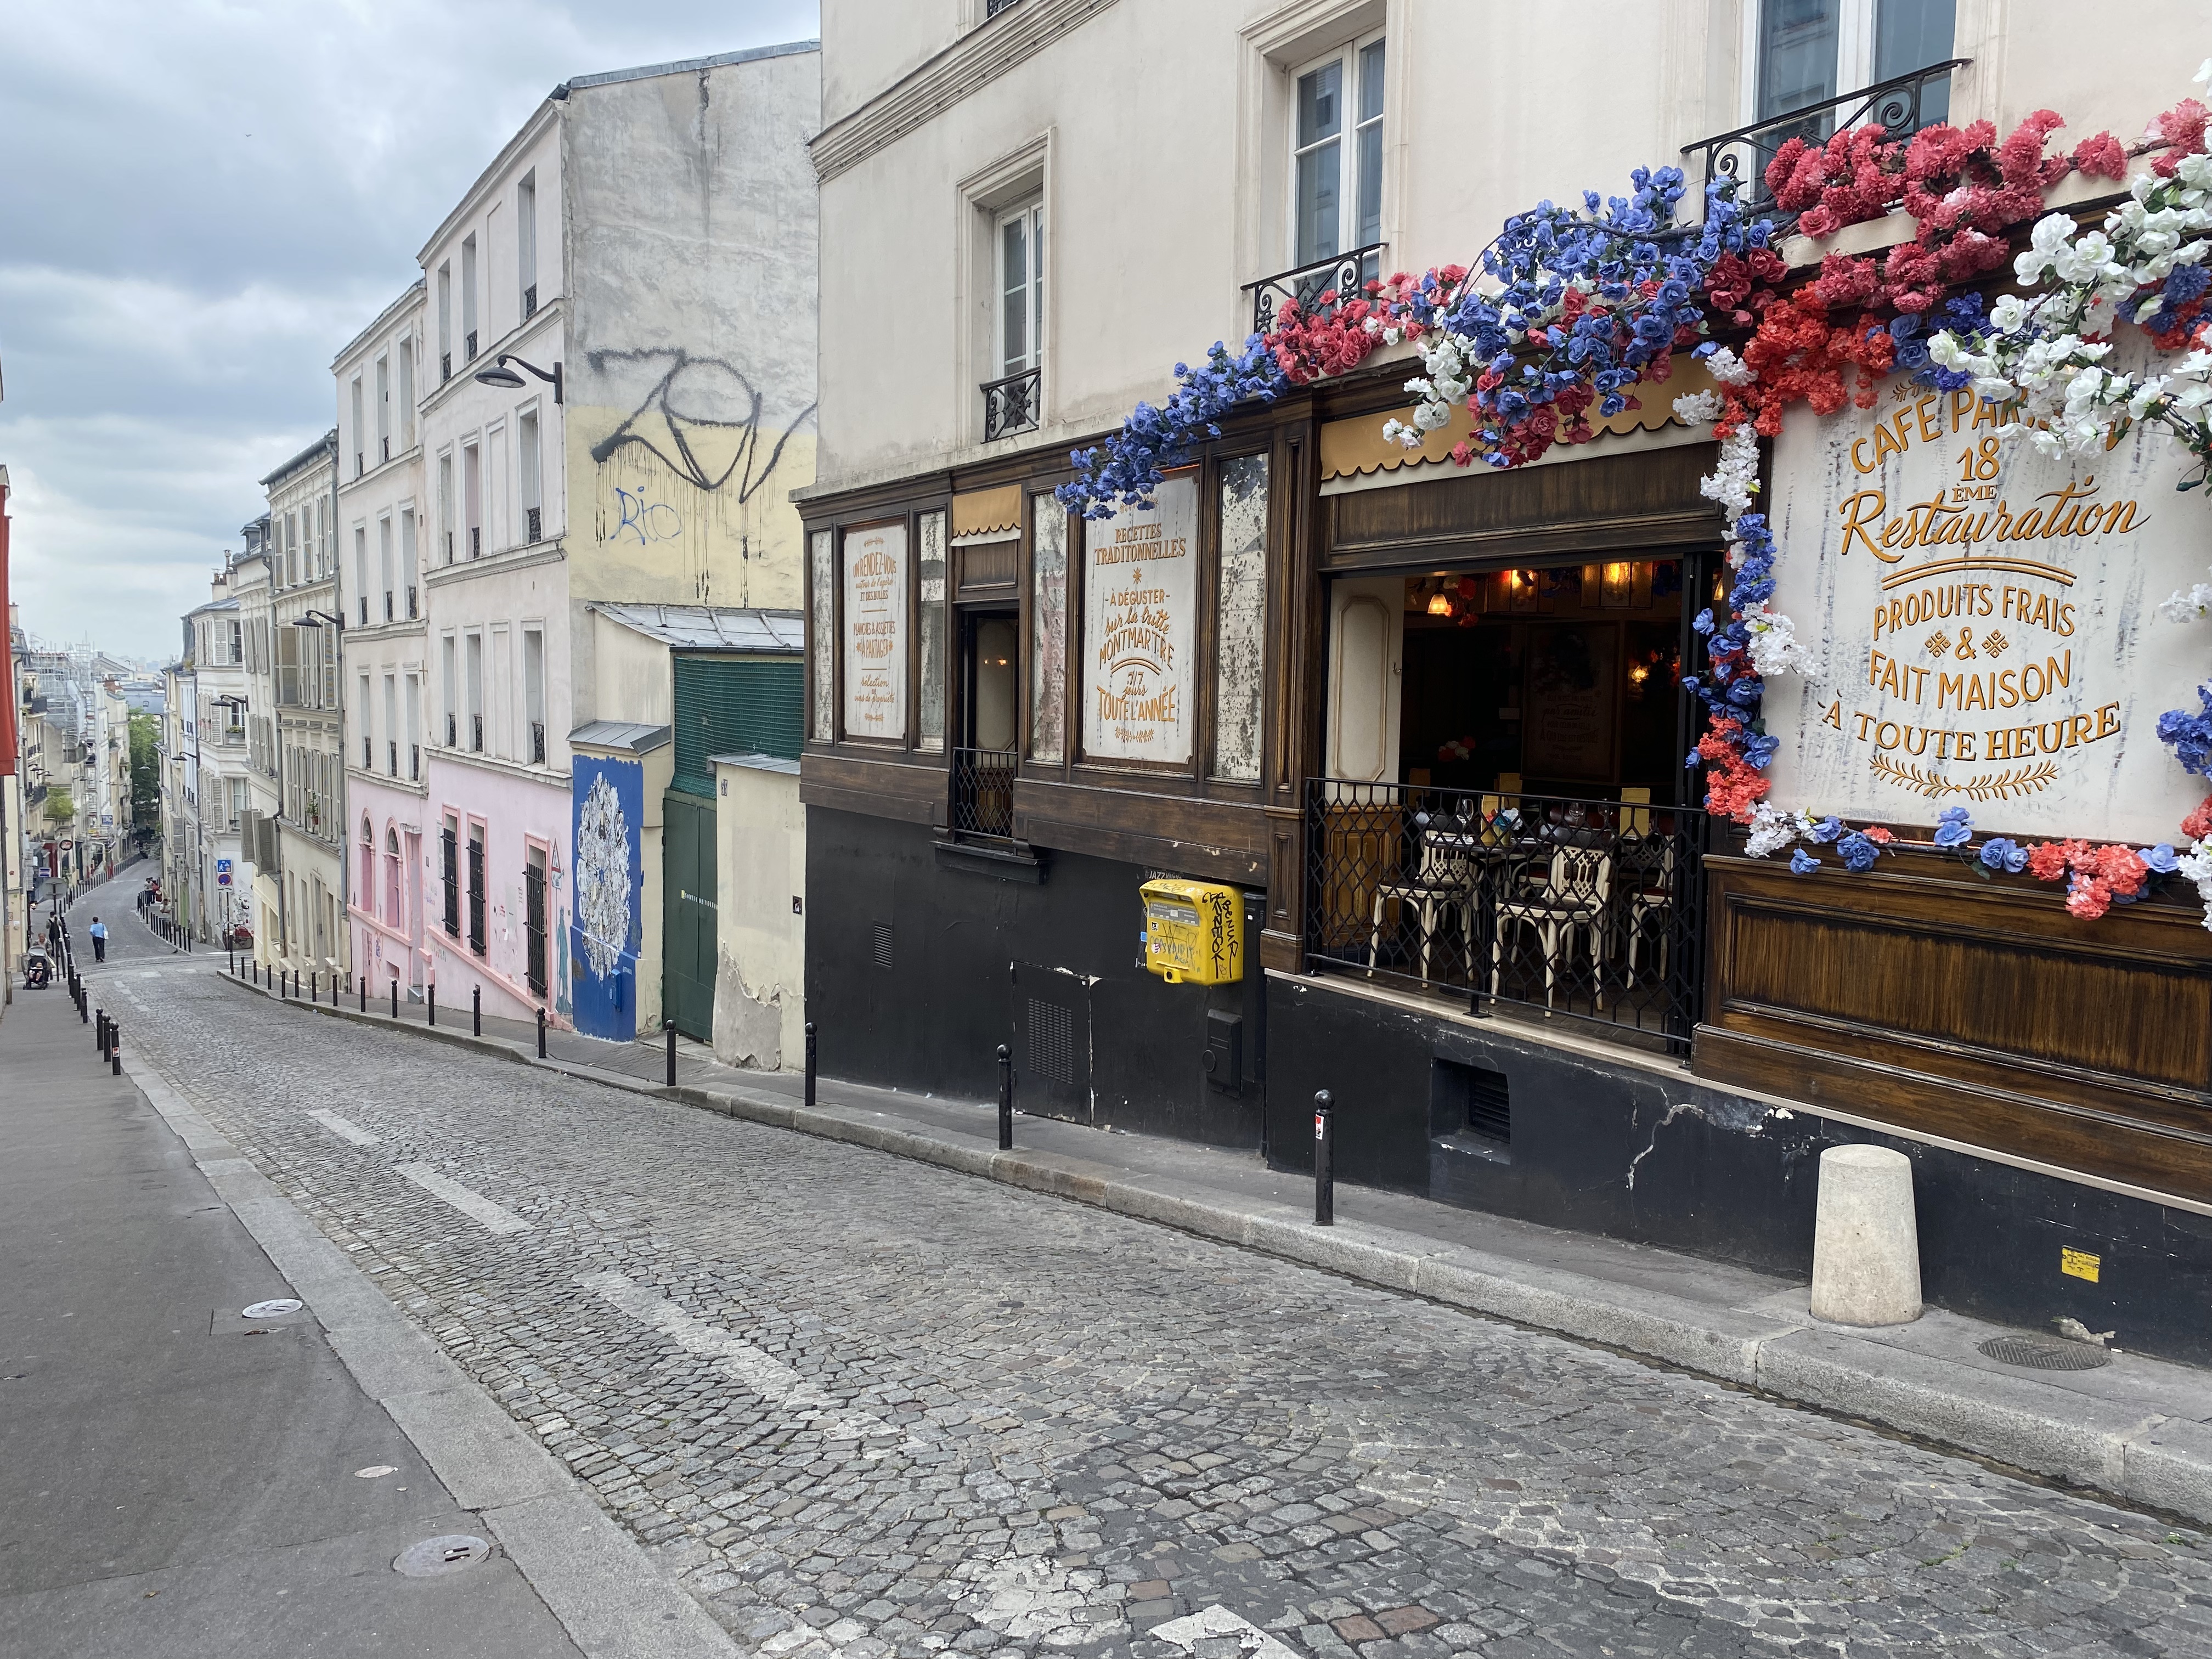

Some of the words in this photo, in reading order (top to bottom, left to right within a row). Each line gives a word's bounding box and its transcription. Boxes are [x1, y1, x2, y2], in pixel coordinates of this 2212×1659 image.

[1956, 436, 2000, 482] 18
[1951, 483, 1998, 503] ÈME
[1115, 522, 1162, 544] RECETTES
[1839, 475, 2152, 564] Restauration
[853, 560, 860, 578] UN
[860, 551, 896, 577] RENDEZ-VOUS
[871, 577, 876, 587] de
[1104, 612, 1123, 637] sur
[1124, 605, 1138, 625] la
[1141, 605, 1170, 634] butte
[1874, 584, 1993, 641] PRODUITS
[2003, 585, 2075, 637] FRAIS
[866, 639, 889, 658] PARTAGER
[1099, 627, 1175, 672] MONTMARTRE
[1954, 627, 1976, 660] &
[861, 674, 889, 687] sélection
[1121, 680, 1149, 700] jours
[1870, 649, 1931, 704] FAIT
[1938, 650, 2070, 711] MAISON
[1097, 685, 1128, 720] TOUTE
[1131, 684, 1176, 721] L'ANNÉE
[1854, 710, 1976, 761] TOUTE
[1984, 701, 2121, 760] HEURE
